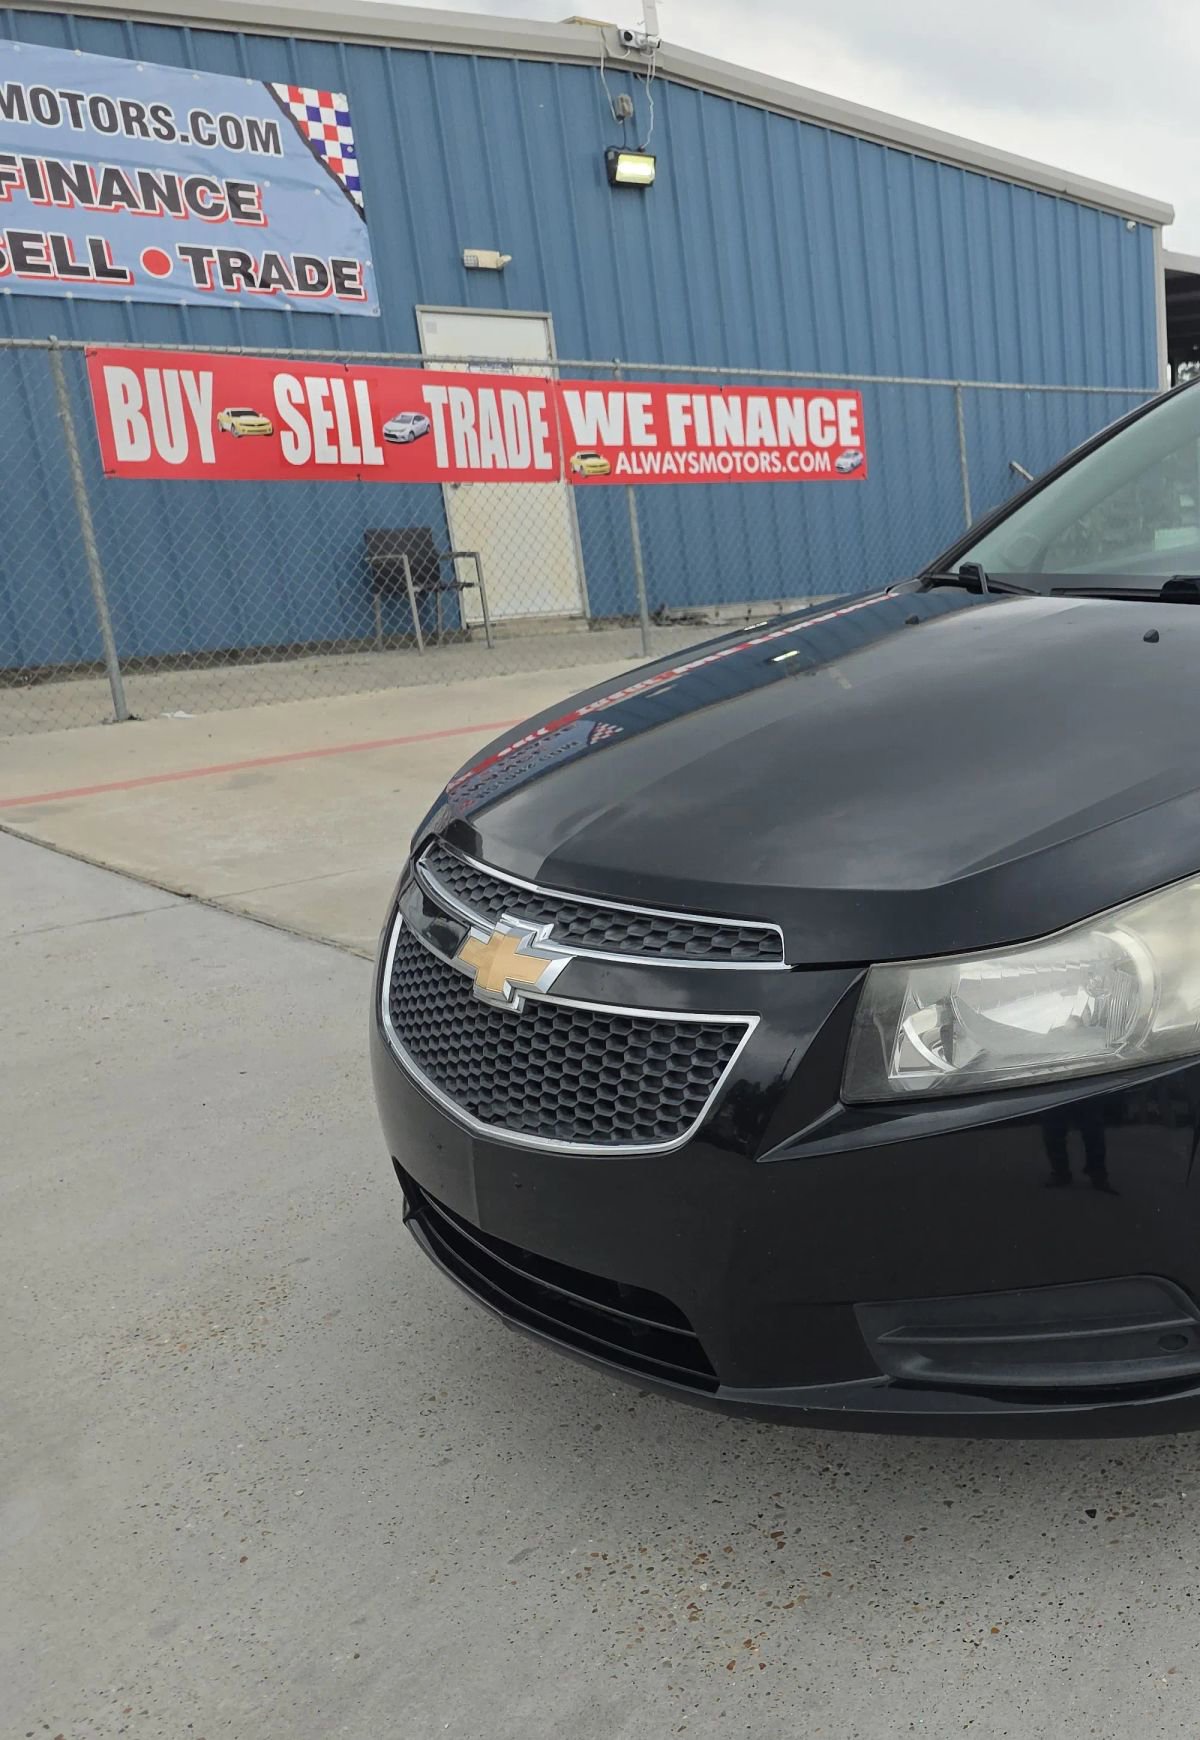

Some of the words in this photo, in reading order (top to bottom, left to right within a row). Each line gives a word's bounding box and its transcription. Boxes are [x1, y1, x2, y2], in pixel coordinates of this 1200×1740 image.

[0, 83, 282, 155] MOTORS.COM
[0, 229, 134, 284] ELL
[176, 243, 367, 301] TRADE
[102, 366, 216, 464] BUY
[273, 373, 385, 466] SELL
[421, 385, 552, 470] TRADE
[564, 391, 657, 447] WE
[667, 394, 860, 447] FINANCE
[615, 451, 832, 475] ALWAYSMOTORS.COM
